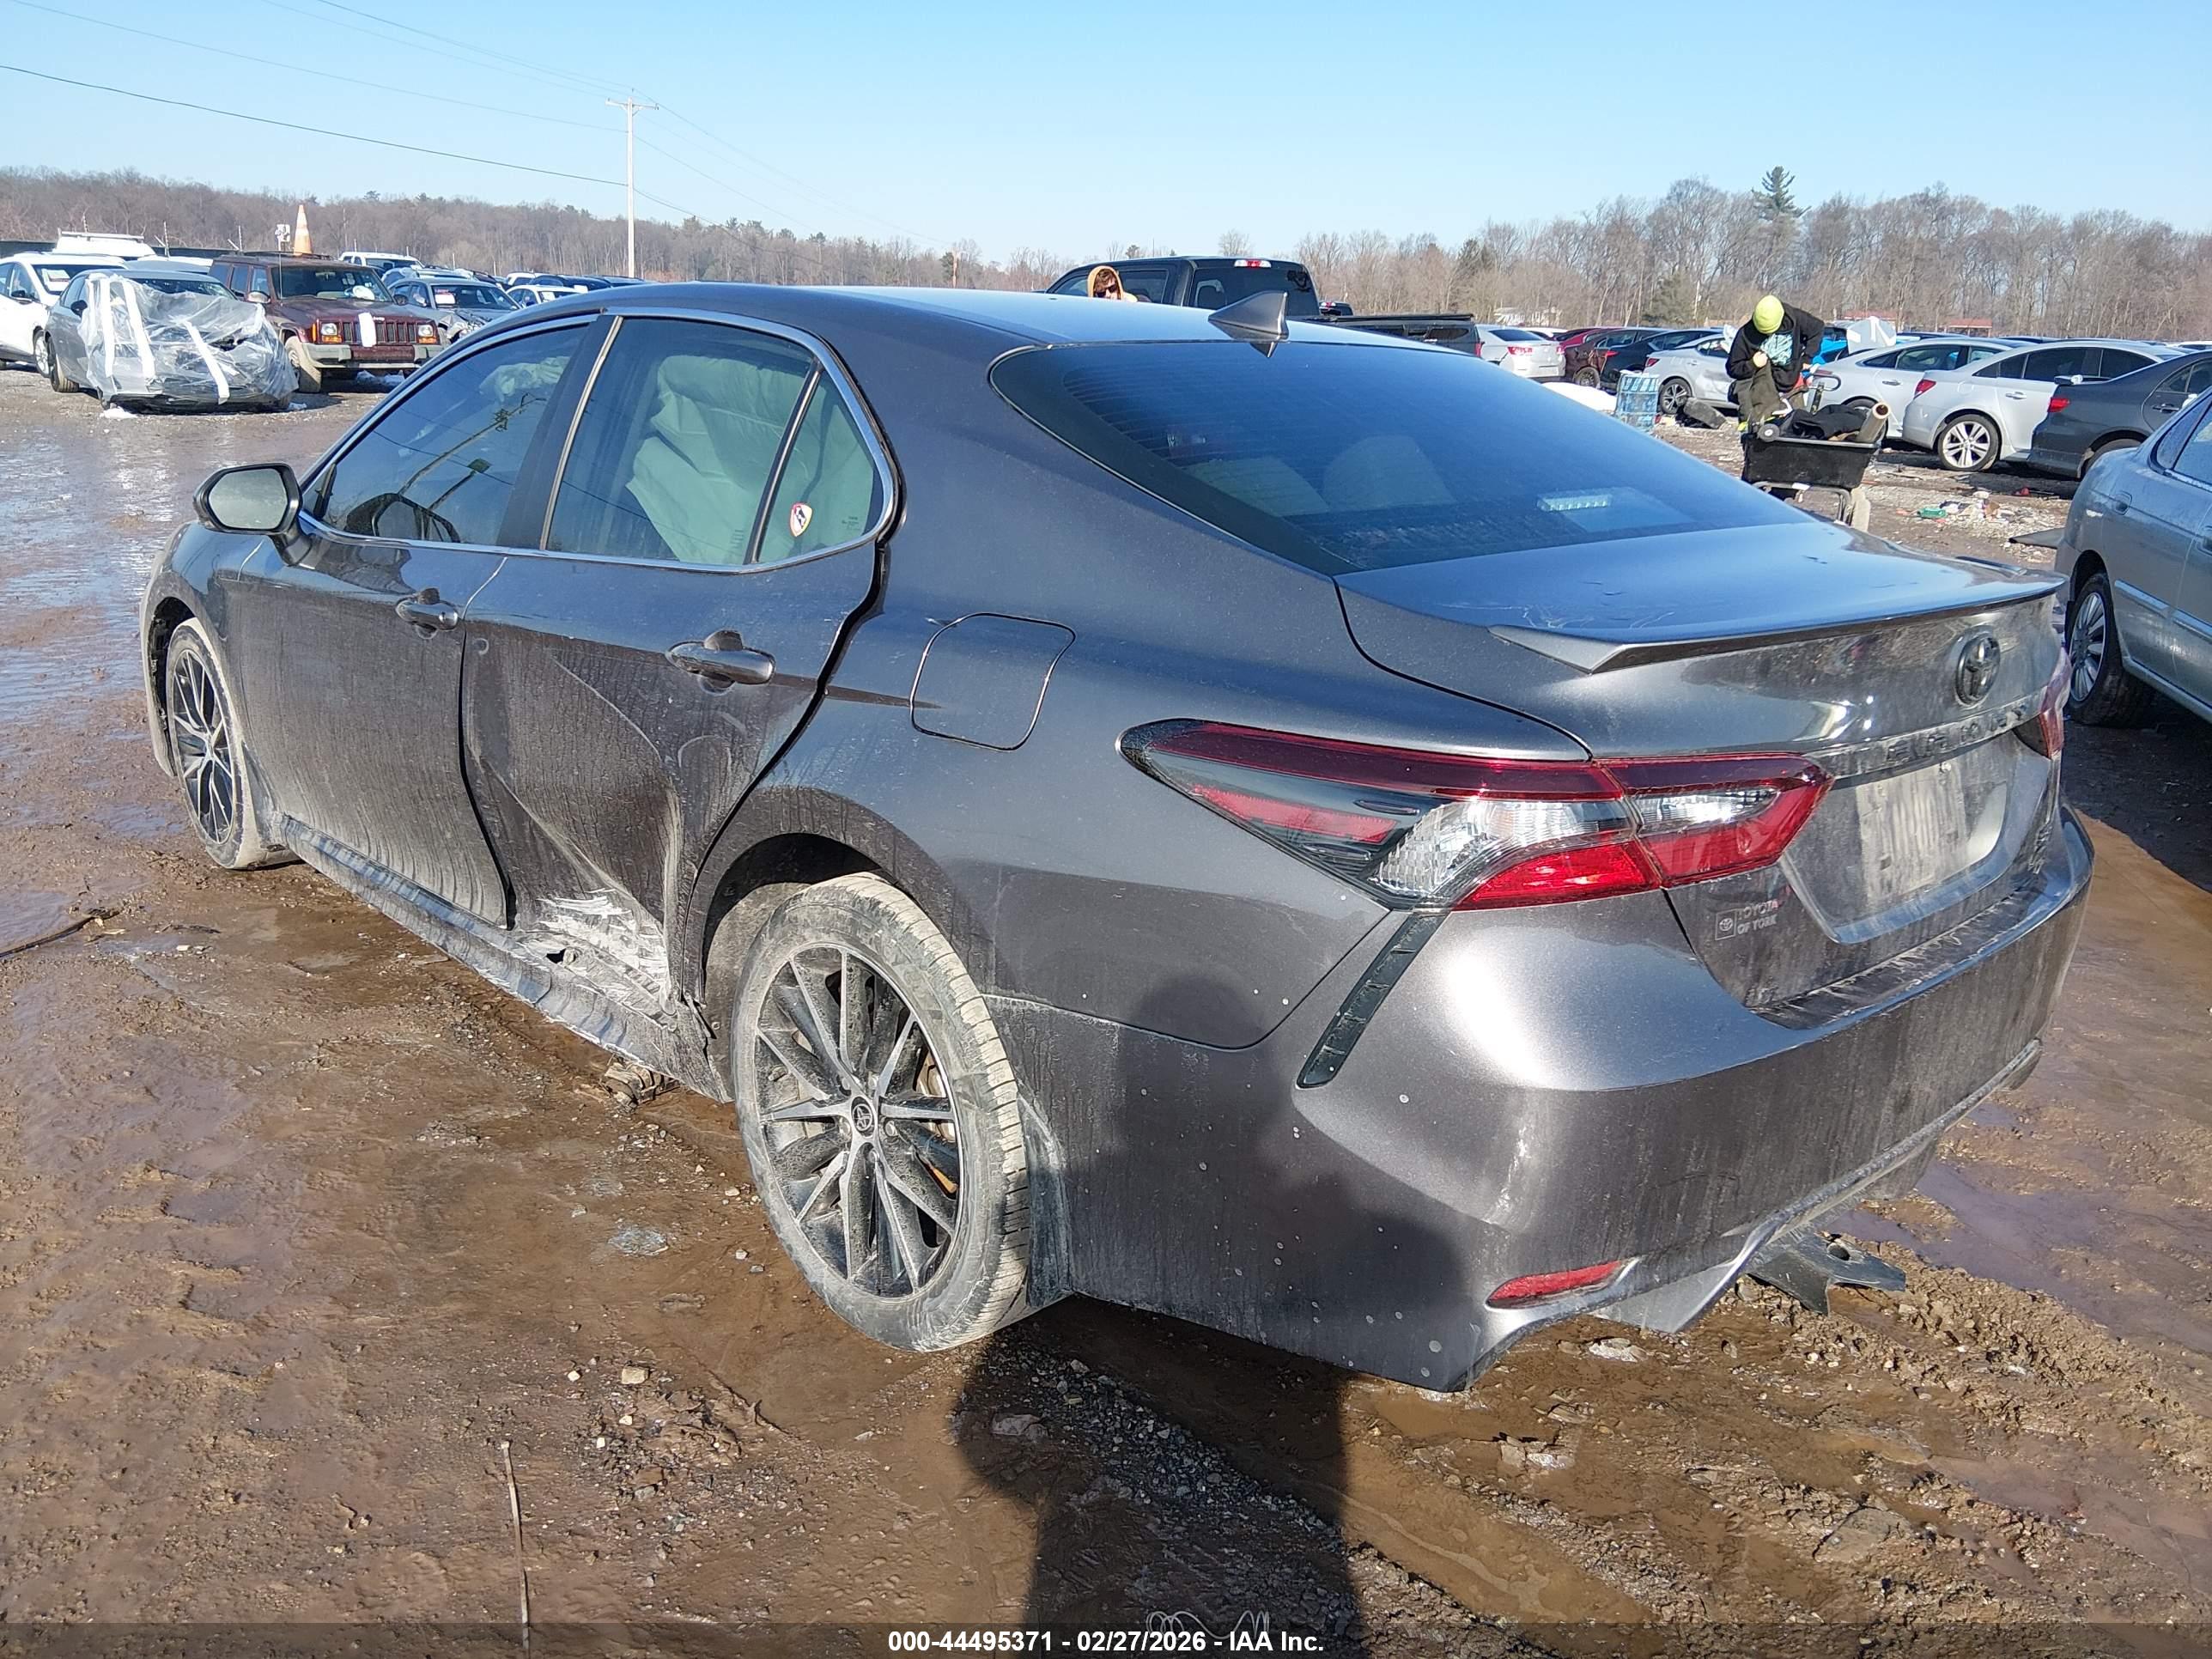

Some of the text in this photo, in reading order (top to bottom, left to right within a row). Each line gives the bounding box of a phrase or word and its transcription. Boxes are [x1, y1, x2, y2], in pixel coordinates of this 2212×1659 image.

[1737, 900, 1778, 920] TOYOTA
[1737, 915, 1778, 934] OF YORK
